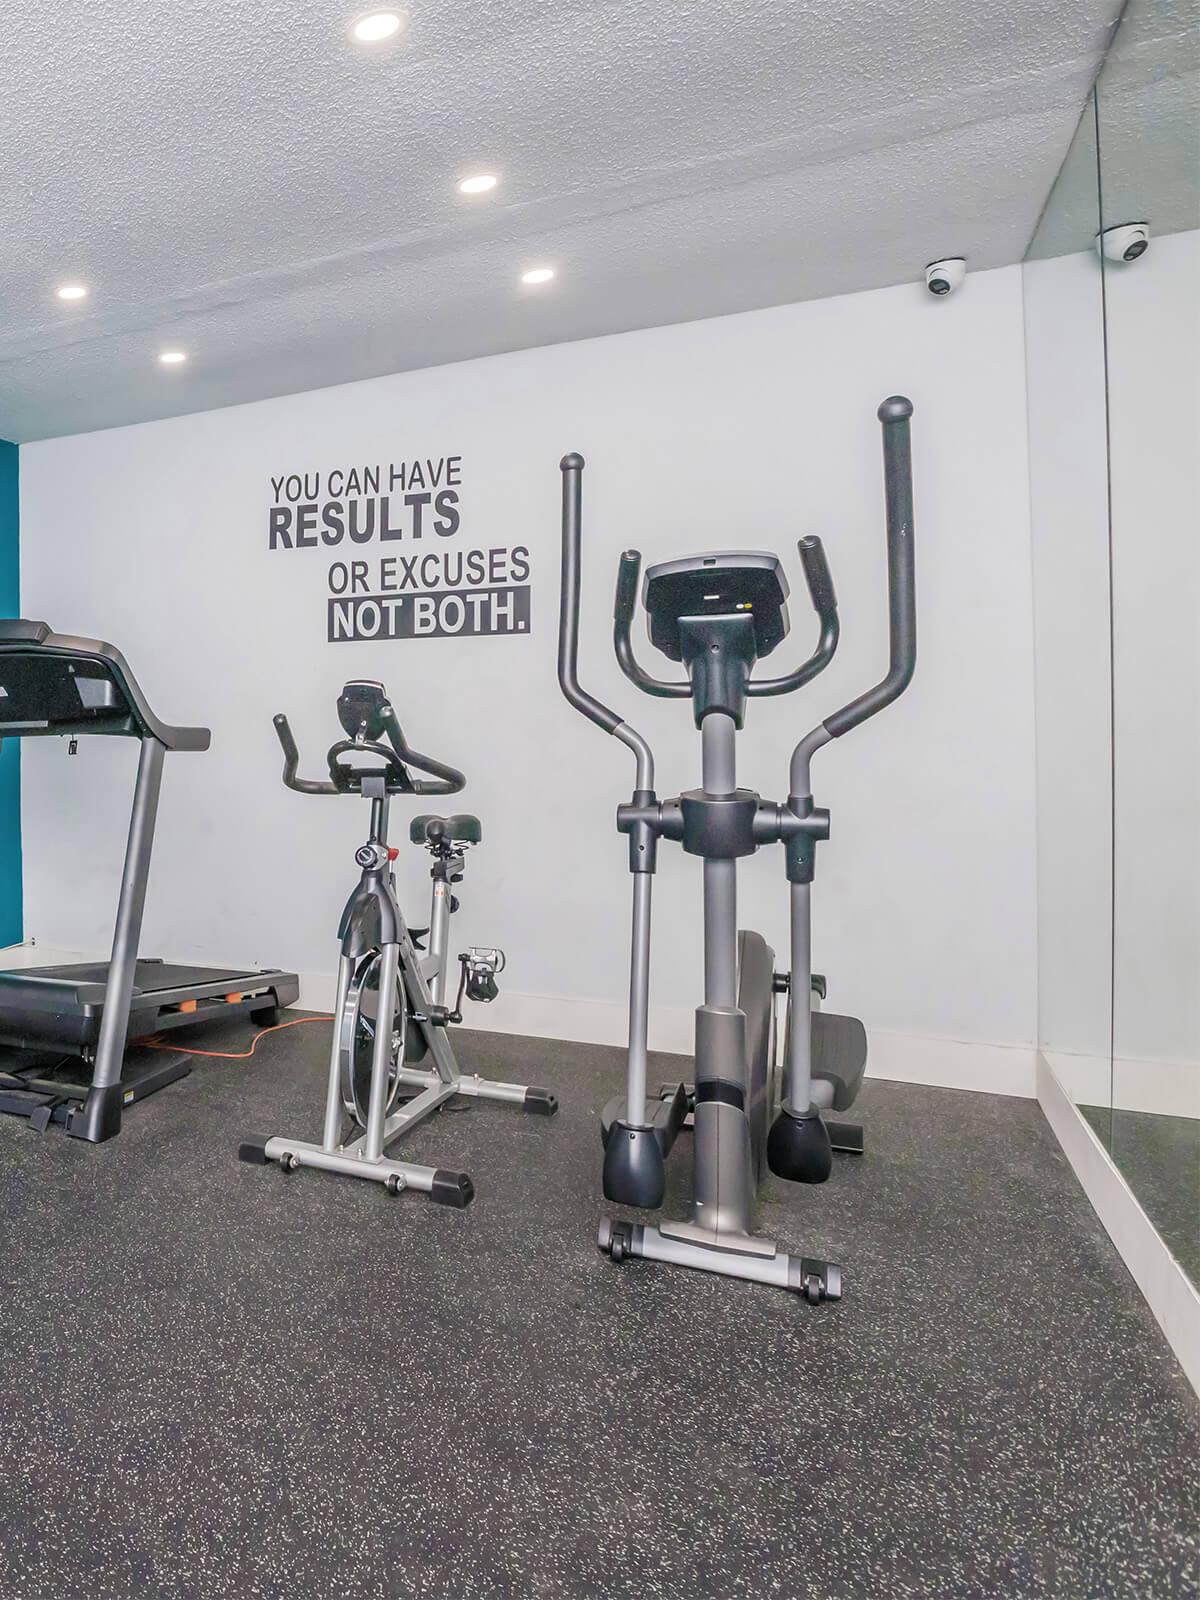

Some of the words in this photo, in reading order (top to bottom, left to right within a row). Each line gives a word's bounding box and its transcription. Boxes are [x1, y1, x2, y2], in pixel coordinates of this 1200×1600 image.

[270, 472, 319, 503] YOU
[328, 465, 379, 498] CAN
[389, 456, 462, 492] HAVE
[269, 490, 460, 550] RESULTS
[328, 561, 370, 594] OR
[381, 546, 530, 591] EXCUSES
[333, 599, 403, 638] NOT
[414, 591, 525, 635] BOTH.
